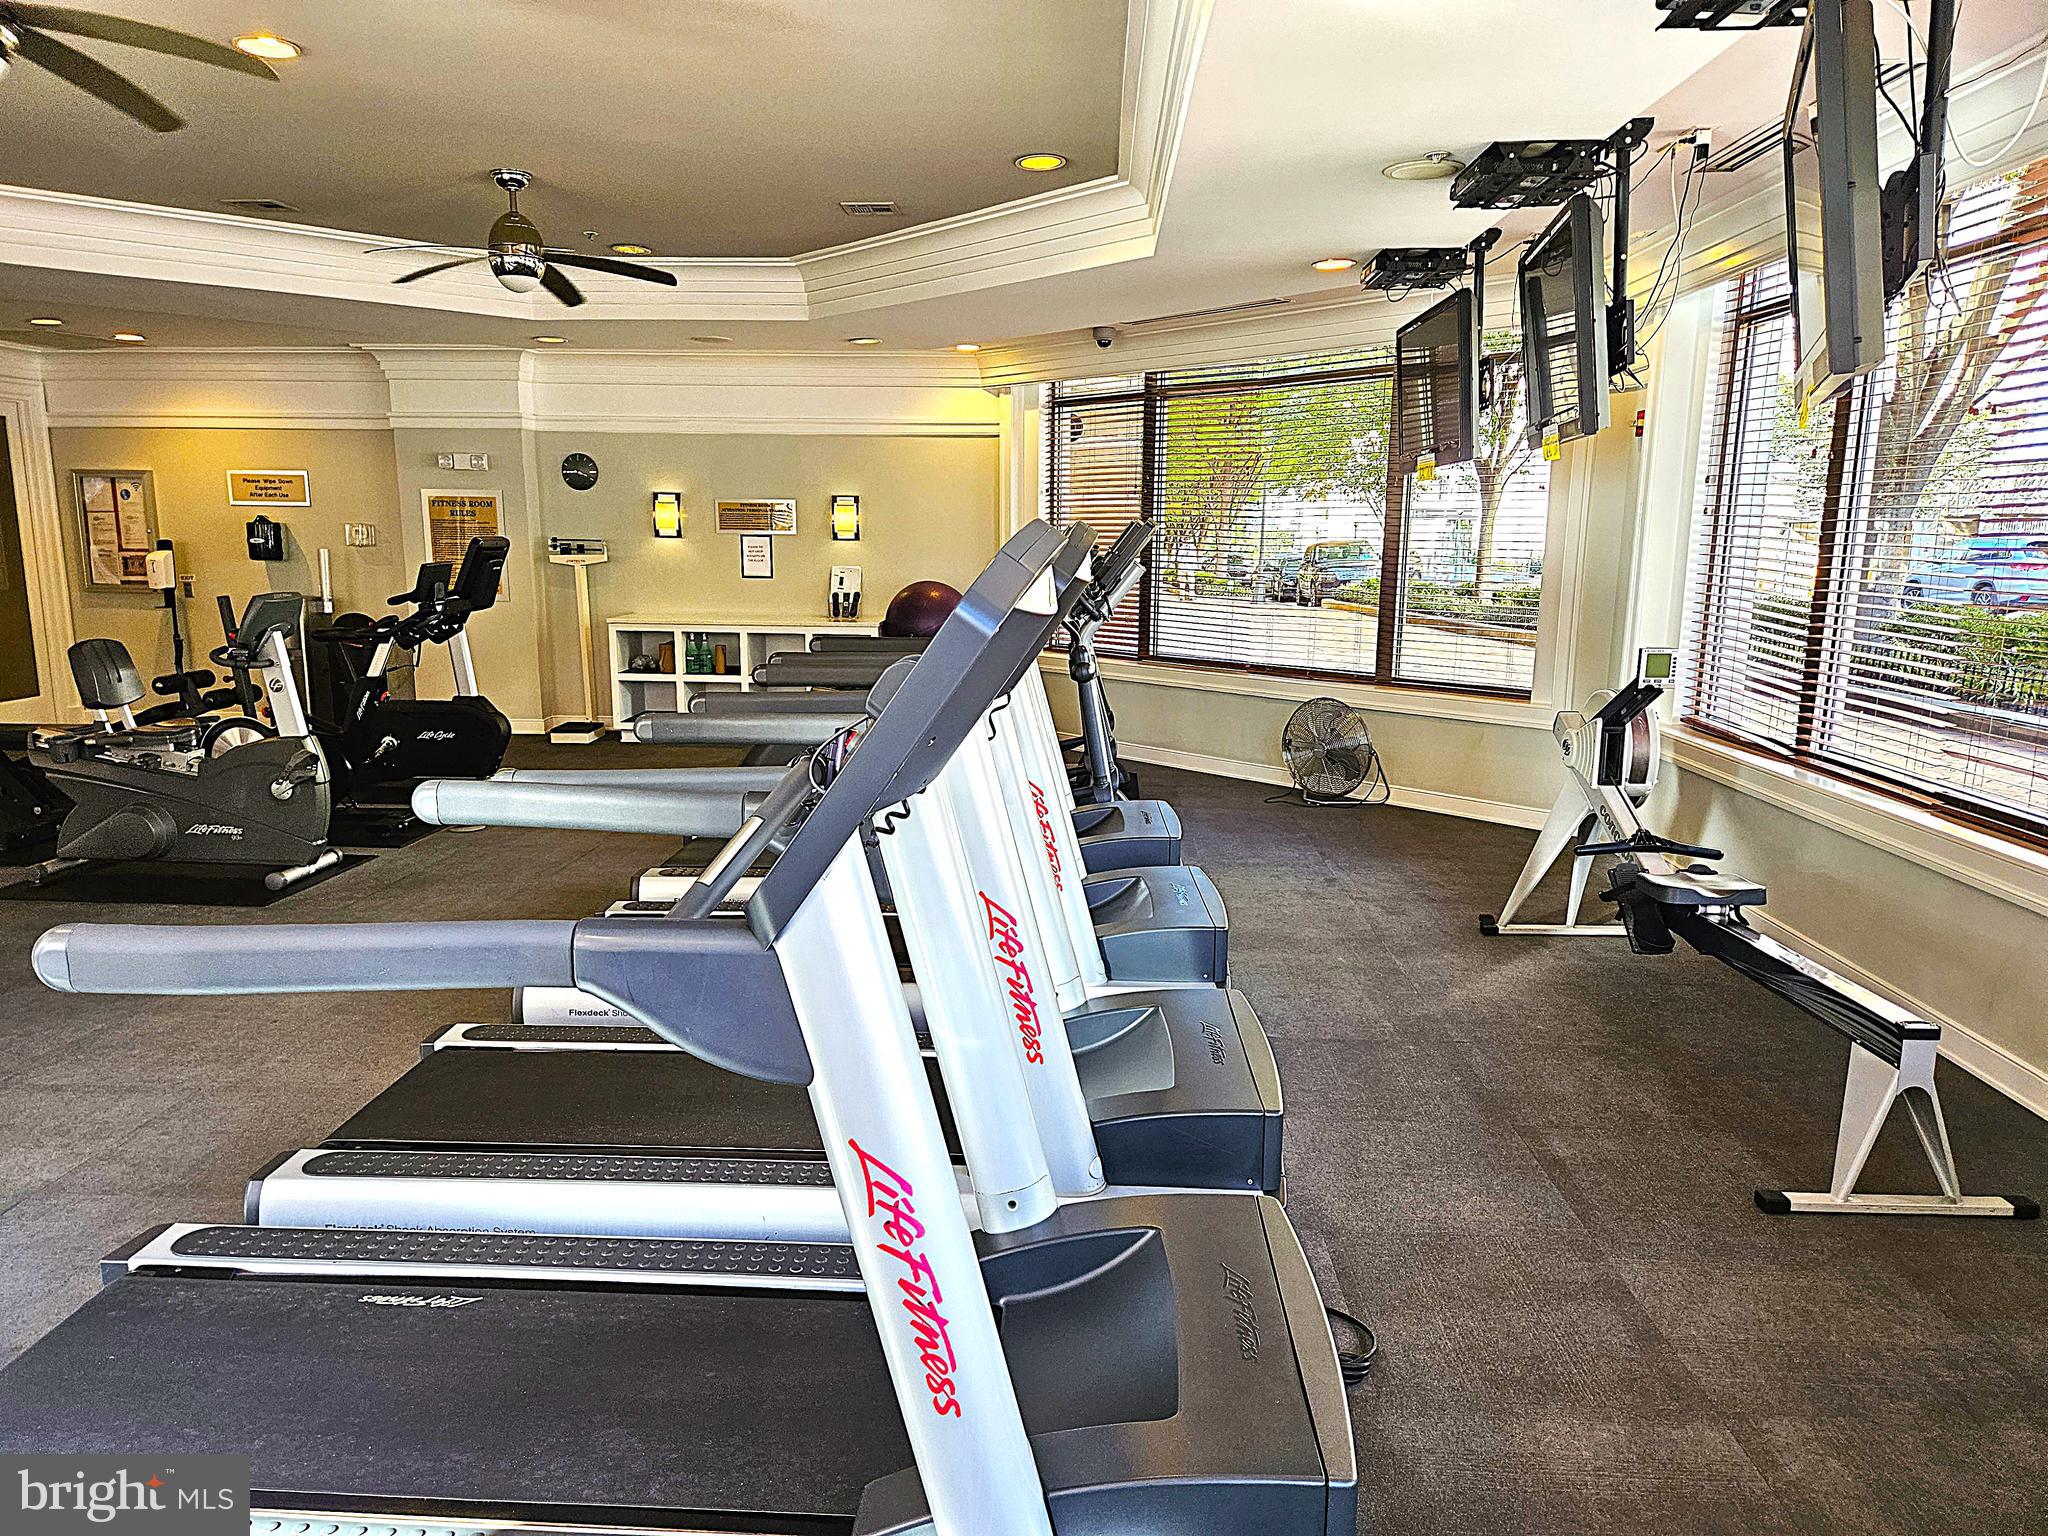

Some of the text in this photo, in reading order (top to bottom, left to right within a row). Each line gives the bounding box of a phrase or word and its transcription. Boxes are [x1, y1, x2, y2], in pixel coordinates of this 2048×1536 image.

[469, 500, 493, 508] ROOM
[449, 509, 477, 517] RULES
[612, 1009, 629, 1017] Sho
